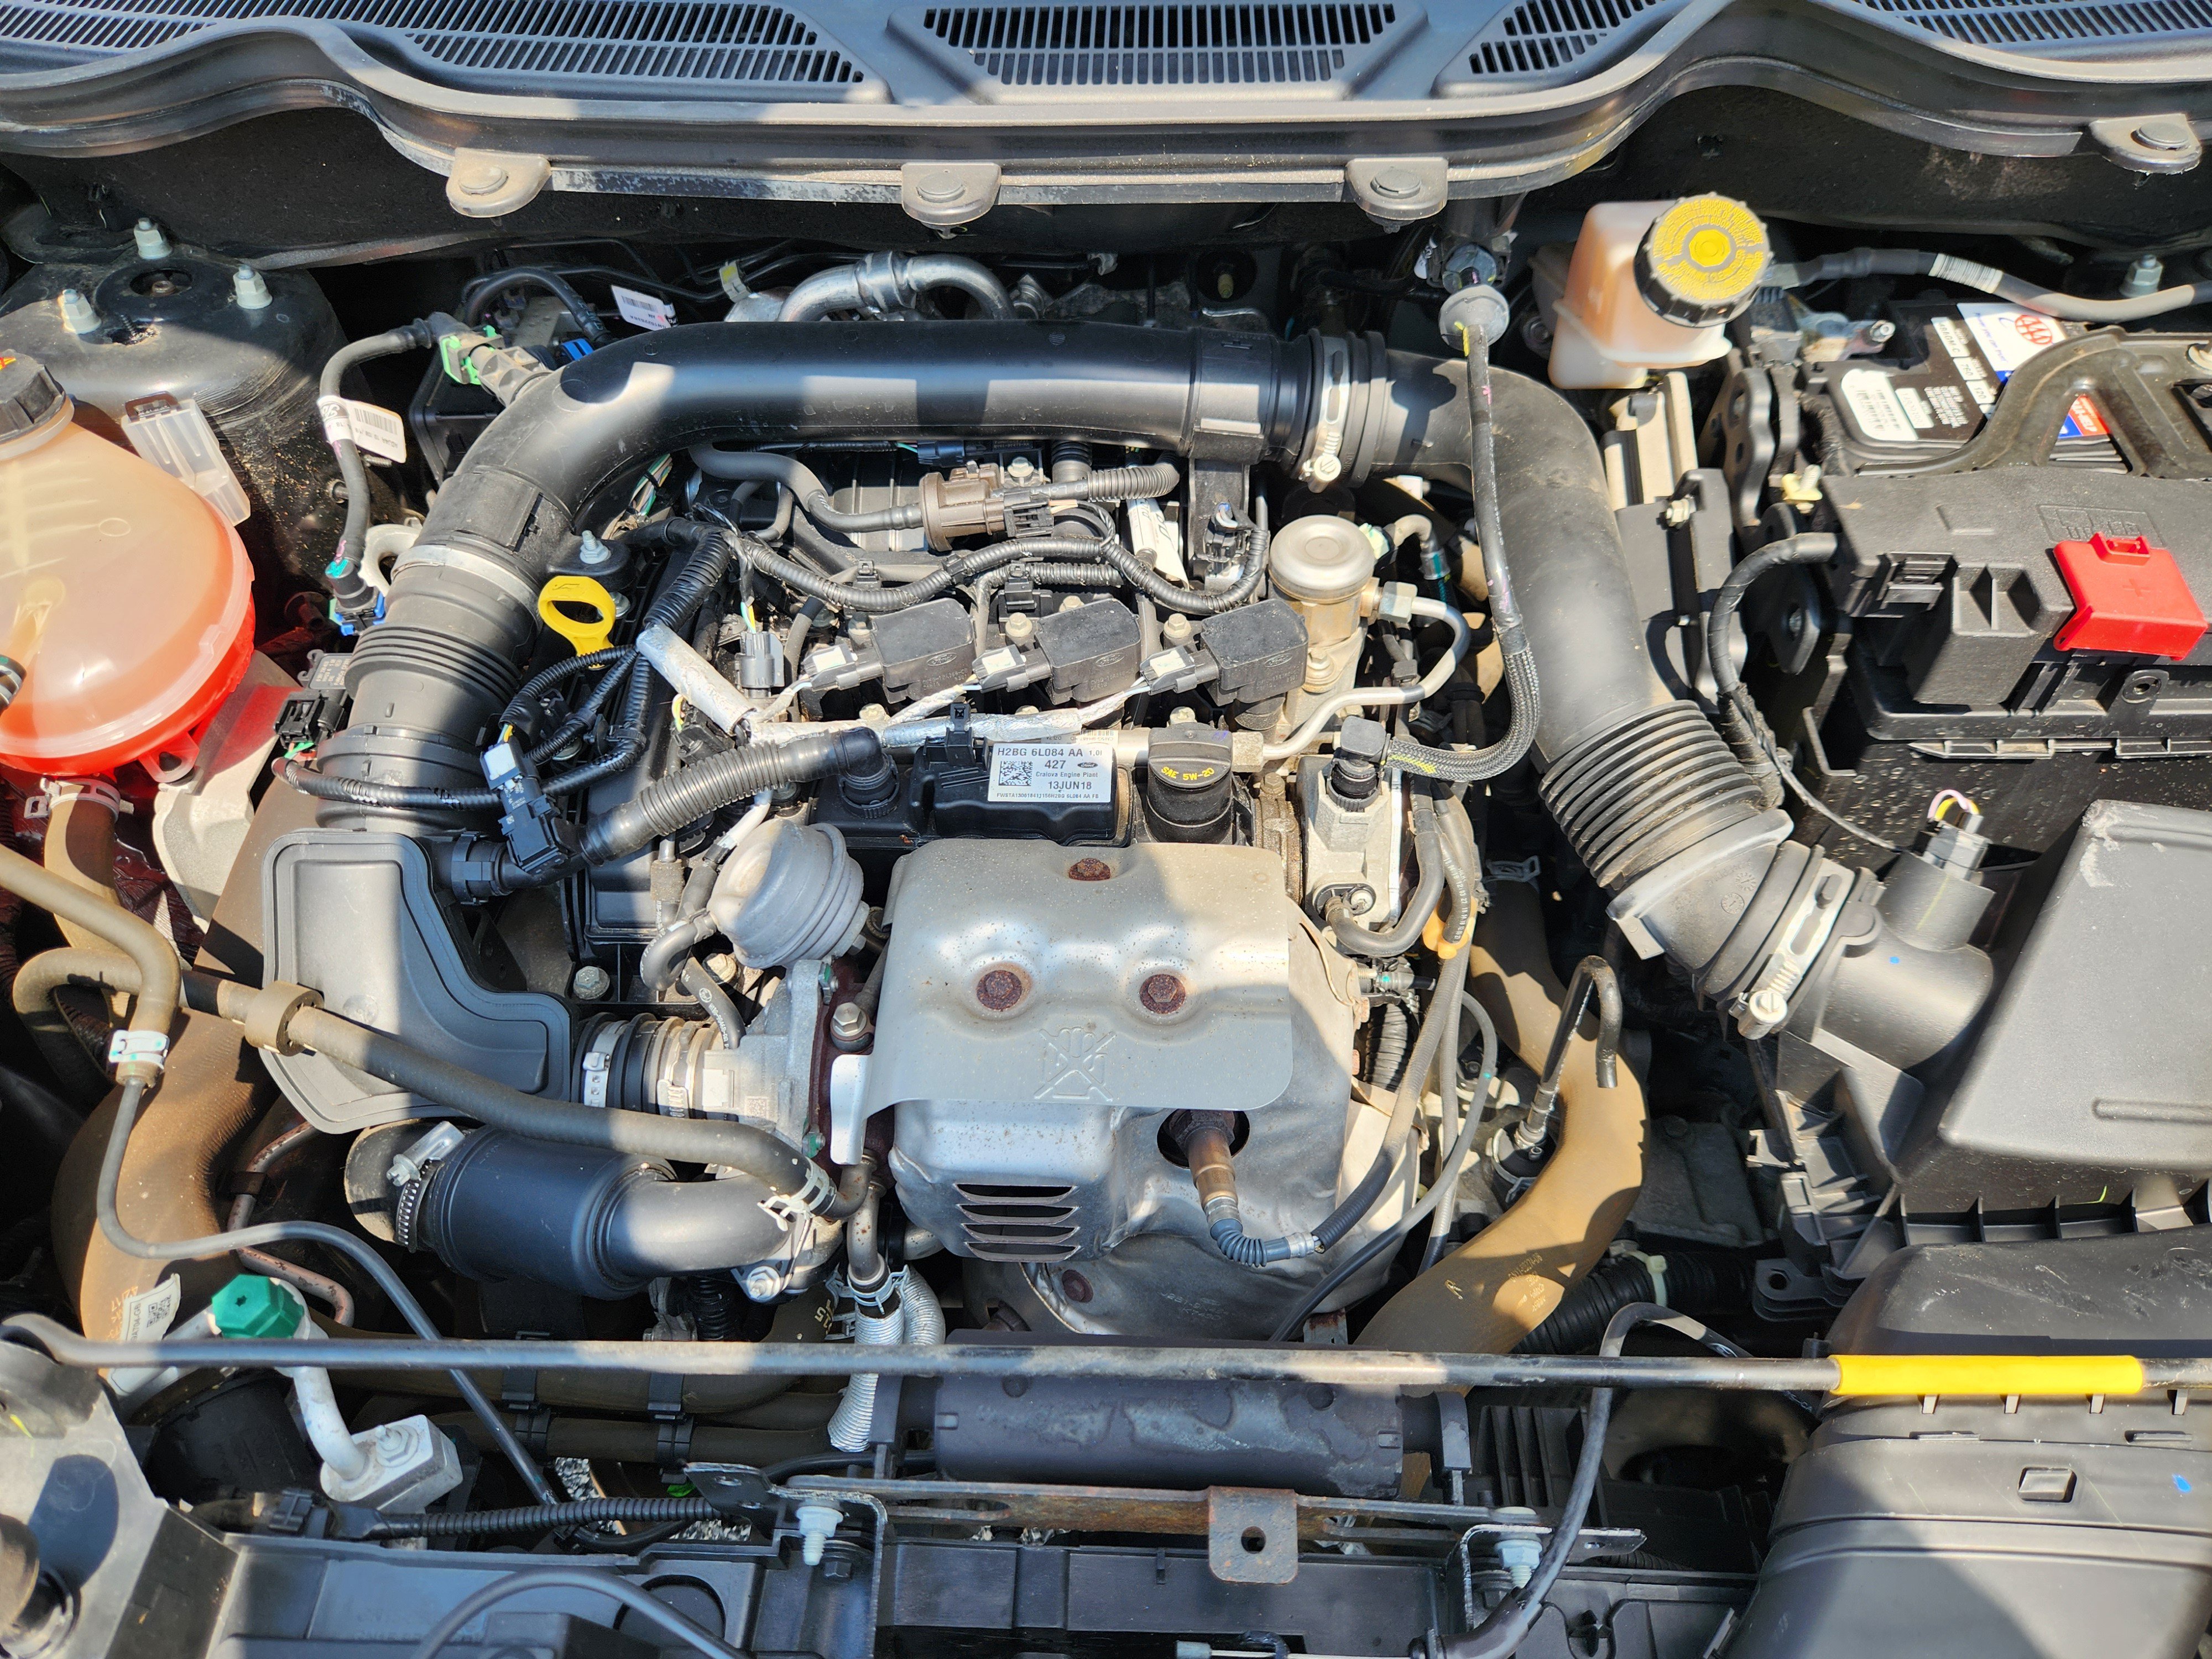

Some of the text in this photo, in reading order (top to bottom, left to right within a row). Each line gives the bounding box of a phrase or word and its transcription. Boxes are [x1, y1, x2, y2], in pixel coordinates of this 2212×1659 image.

[998, 748, 1026, 756] H2BG
[1031, 748, 1064, 757] 6L084
[1045, 760, 1066, 769] 427
[1161, 766, 1214, 781] SAE 5W-20
[1048, 781, 1092, 790] 13JUN18
